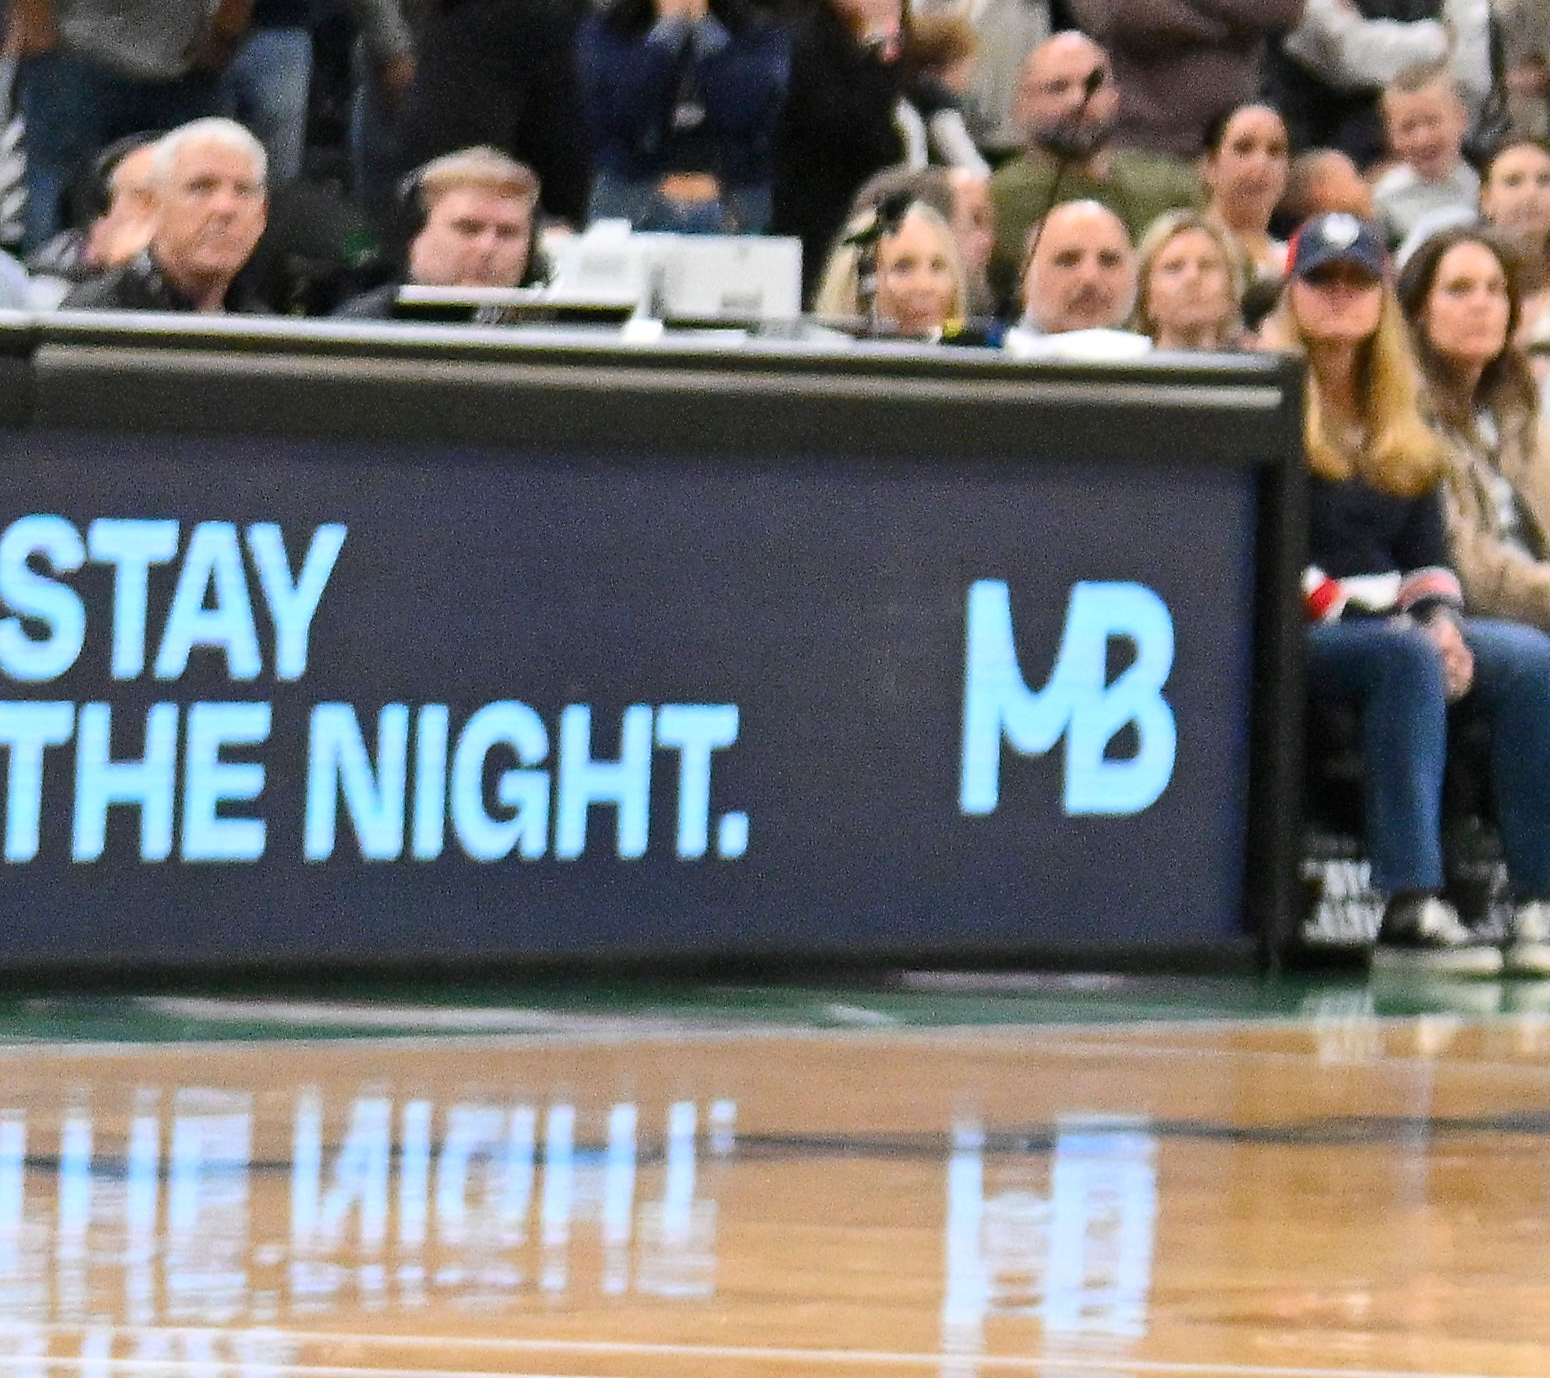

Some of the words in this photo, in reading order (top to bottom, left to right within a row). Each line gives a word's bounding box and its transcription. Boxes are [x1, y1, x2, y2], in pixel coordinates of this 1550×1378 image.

[0, 515, 348, 685] STAY
[0, 699, 273, 865] THE
[302, 699, 750, 865] NIGHT.
